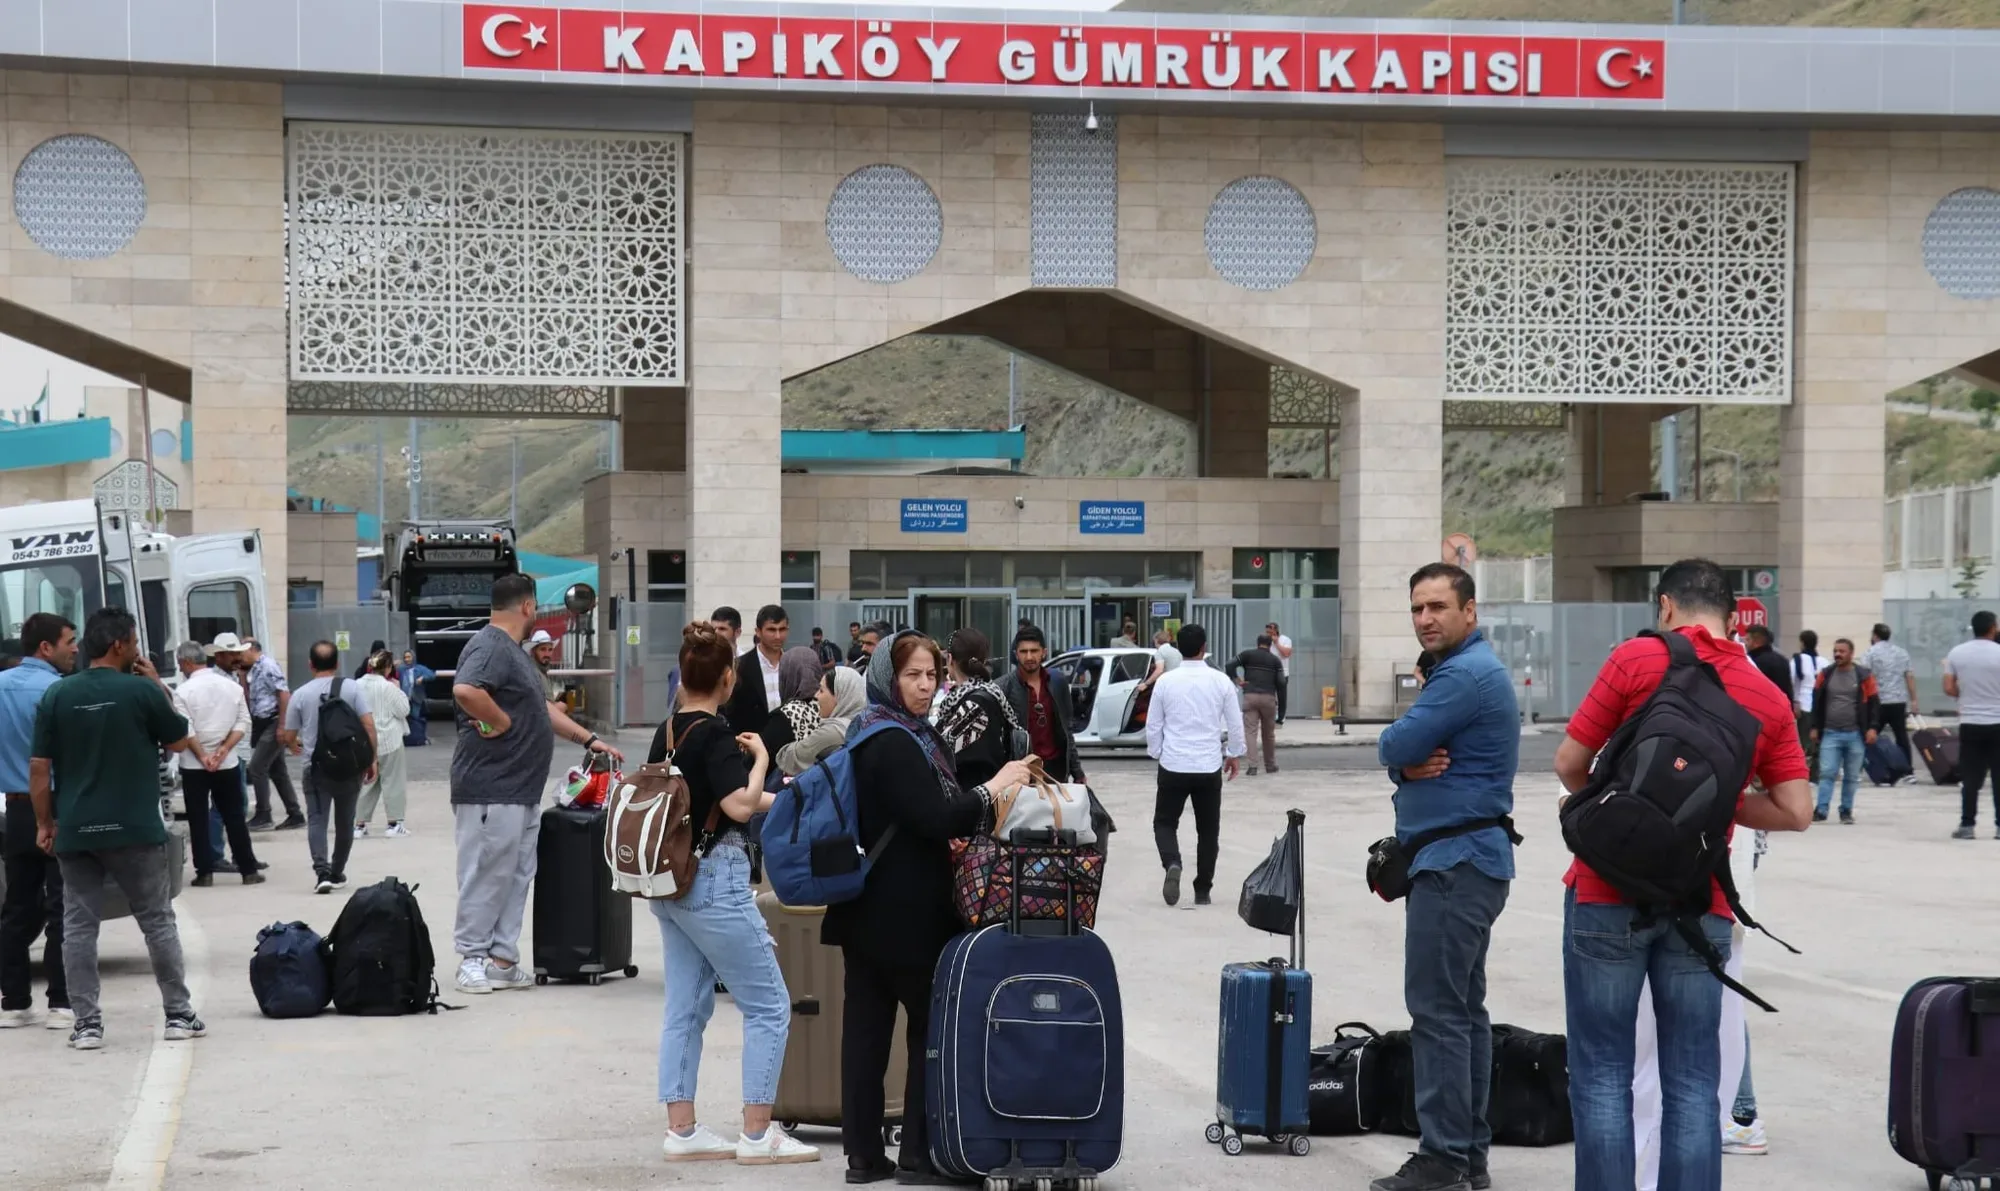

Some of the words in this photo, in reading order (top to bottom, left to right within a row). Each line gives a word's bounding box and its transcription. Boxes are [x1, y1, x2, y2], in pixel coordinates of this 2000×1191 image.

[603, 21, 962, 80] KAPIKÖY
[998, 28, 1291, 89] GÜMRÜK
[1318, 48, 1542, 95] KAPISI
[907, 503, 933, 511] GELEN
[935, 503, 961, 511] YOLCU
[1088, 505, 1110, 514] GİDEN
[1112, 507, 1137, 515] YOLCU
[9, 531, 94, 549] VAN
[12, 550, 40, 561] 0543
[43, 547, 63, 557] 786
[66, 544, 93, 555] 9293
[1309, 1081, 1344, 1091] adidas
